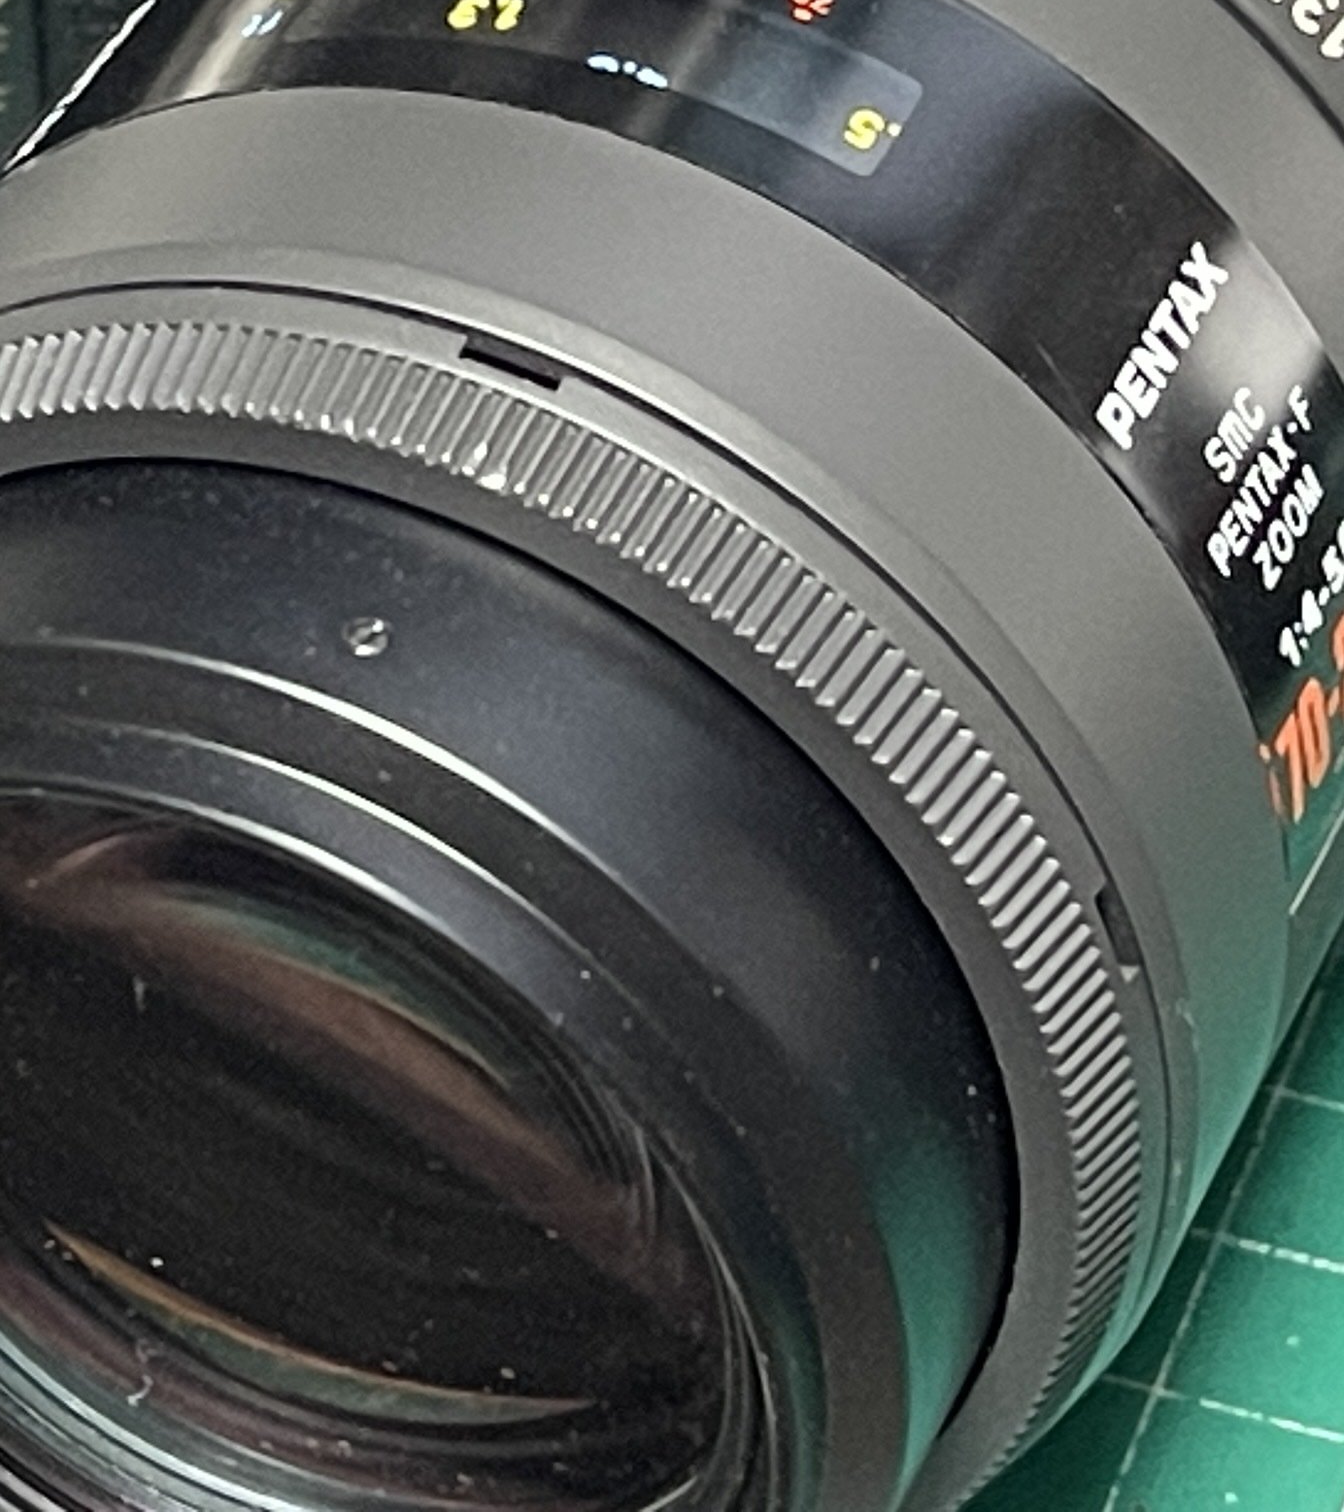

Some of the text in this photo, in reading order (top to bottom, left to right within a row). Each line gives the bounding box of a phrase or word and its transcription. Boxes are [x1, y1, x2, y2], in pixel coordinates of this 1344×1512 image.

[1094, 240, 1230, 451] PENTAX
[1202, 386, 1266, 483] SMC
[1252, 463, 1325, 591] ZOOM
